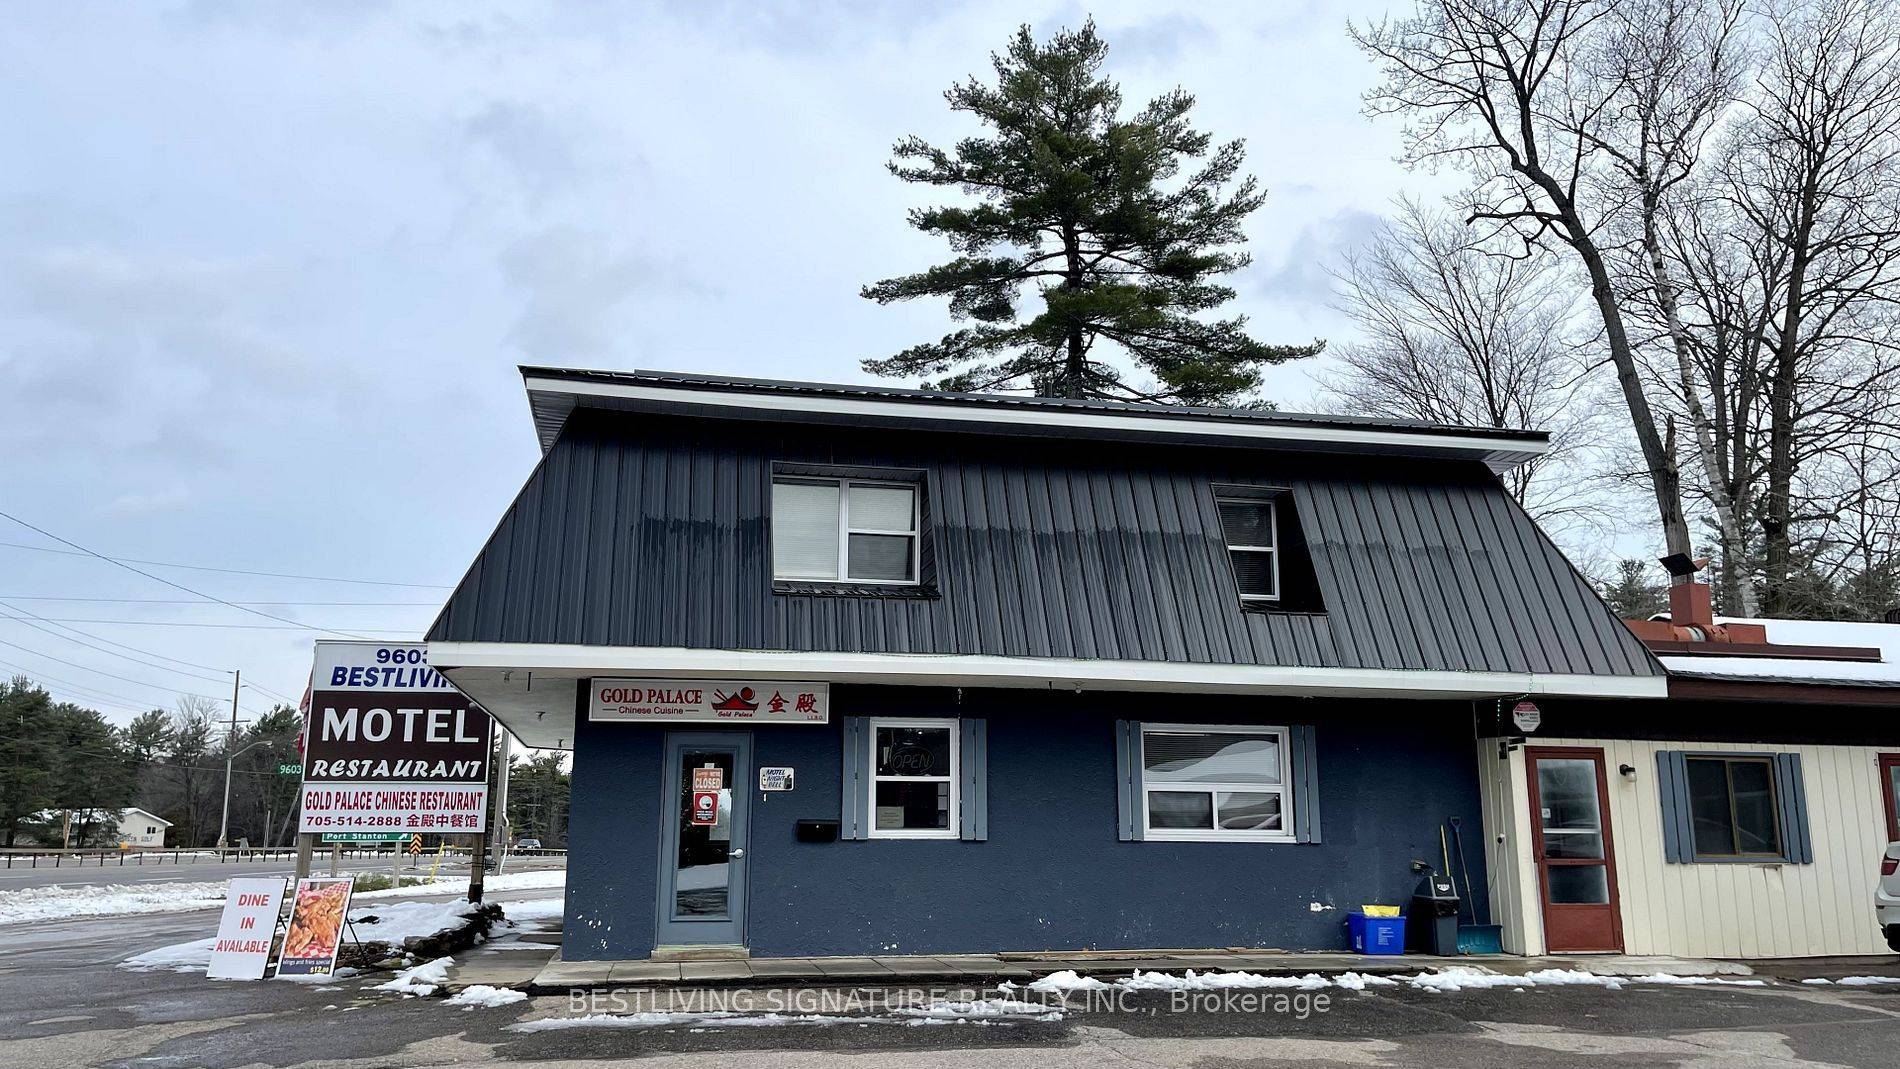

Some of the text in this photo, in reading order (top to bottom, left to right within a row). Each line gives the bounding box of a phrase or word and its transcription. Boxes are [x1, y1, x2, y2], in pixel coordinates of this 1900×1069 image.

[330, 666, 454, 688] BESTLIVI
[600, 688, 703, 704] GOLD PALACE
[766, 690, 818, 713] 金殿
[618, 706, 684, 715] Chinese Cuisine
[321, 708, 480, 743] MOTEL
[311, 759, 482, 778] RESTAURANT
[893, 754, 931, 769] OPEN
[279, 764, 301, 775] 9603
[695, 778, 720, 789] CLOSED
[305, 791, 483, 811] GOLD PALACE CHINESE RESTAURANT
[306, 814, 479, 828] 705-514-2888 金殿中餐馆
[238, 894, 270, 907] DINE
[240, 917, 256, 930] IN
[216, 940, 269, 953] AVAILABLE
